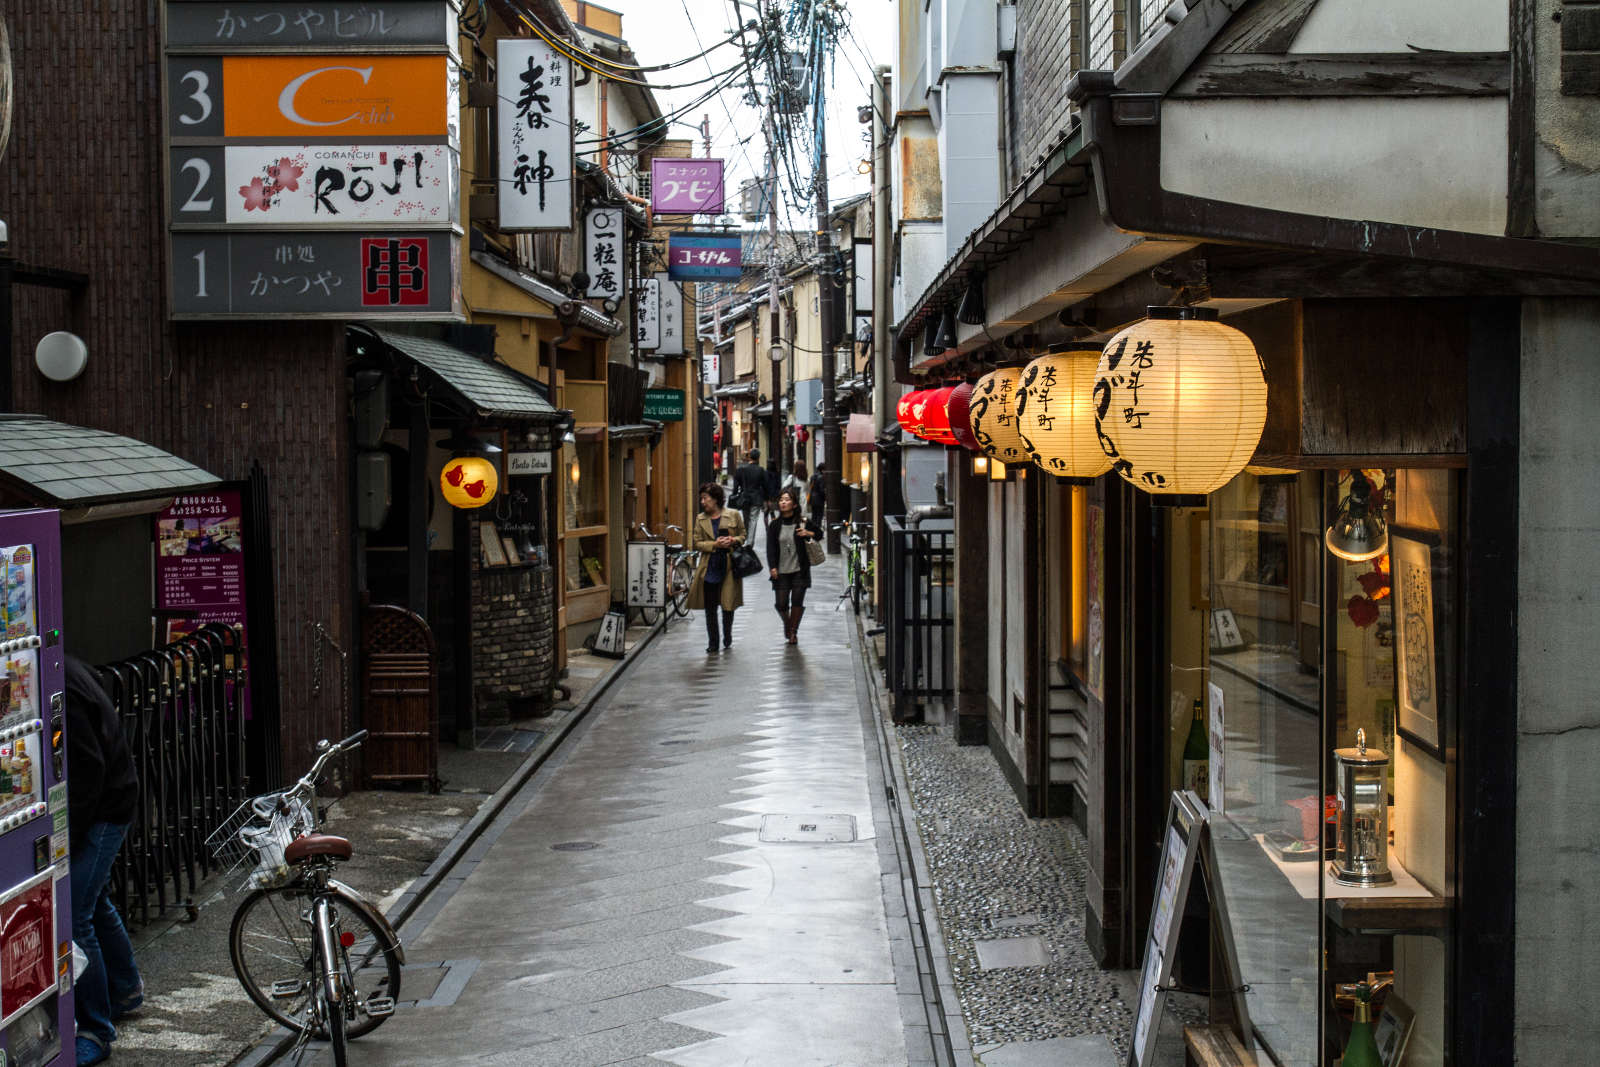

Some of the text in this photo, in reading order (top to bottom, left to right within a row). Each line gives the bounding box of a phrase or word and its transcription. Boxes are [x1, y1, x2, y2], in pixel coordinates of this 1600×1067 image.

[215, 8, 398, 40] かつやビル
[178, 69, 212, 125] 3
[179, 157, 214, 212] 2
[660, 180, 715, 203] ブービー
[192, 249, 209, 297] 1
[249, 269, 343, 298] かつや
[366, 239, 426, 305] 串
[592, 231, 618, 293] 一粒庵
[996, 378, 1014, 427] 先斗町
[1036, 365, 1057, 432] 先斗町
[1123, 339, 1155, 430] 先斗町
